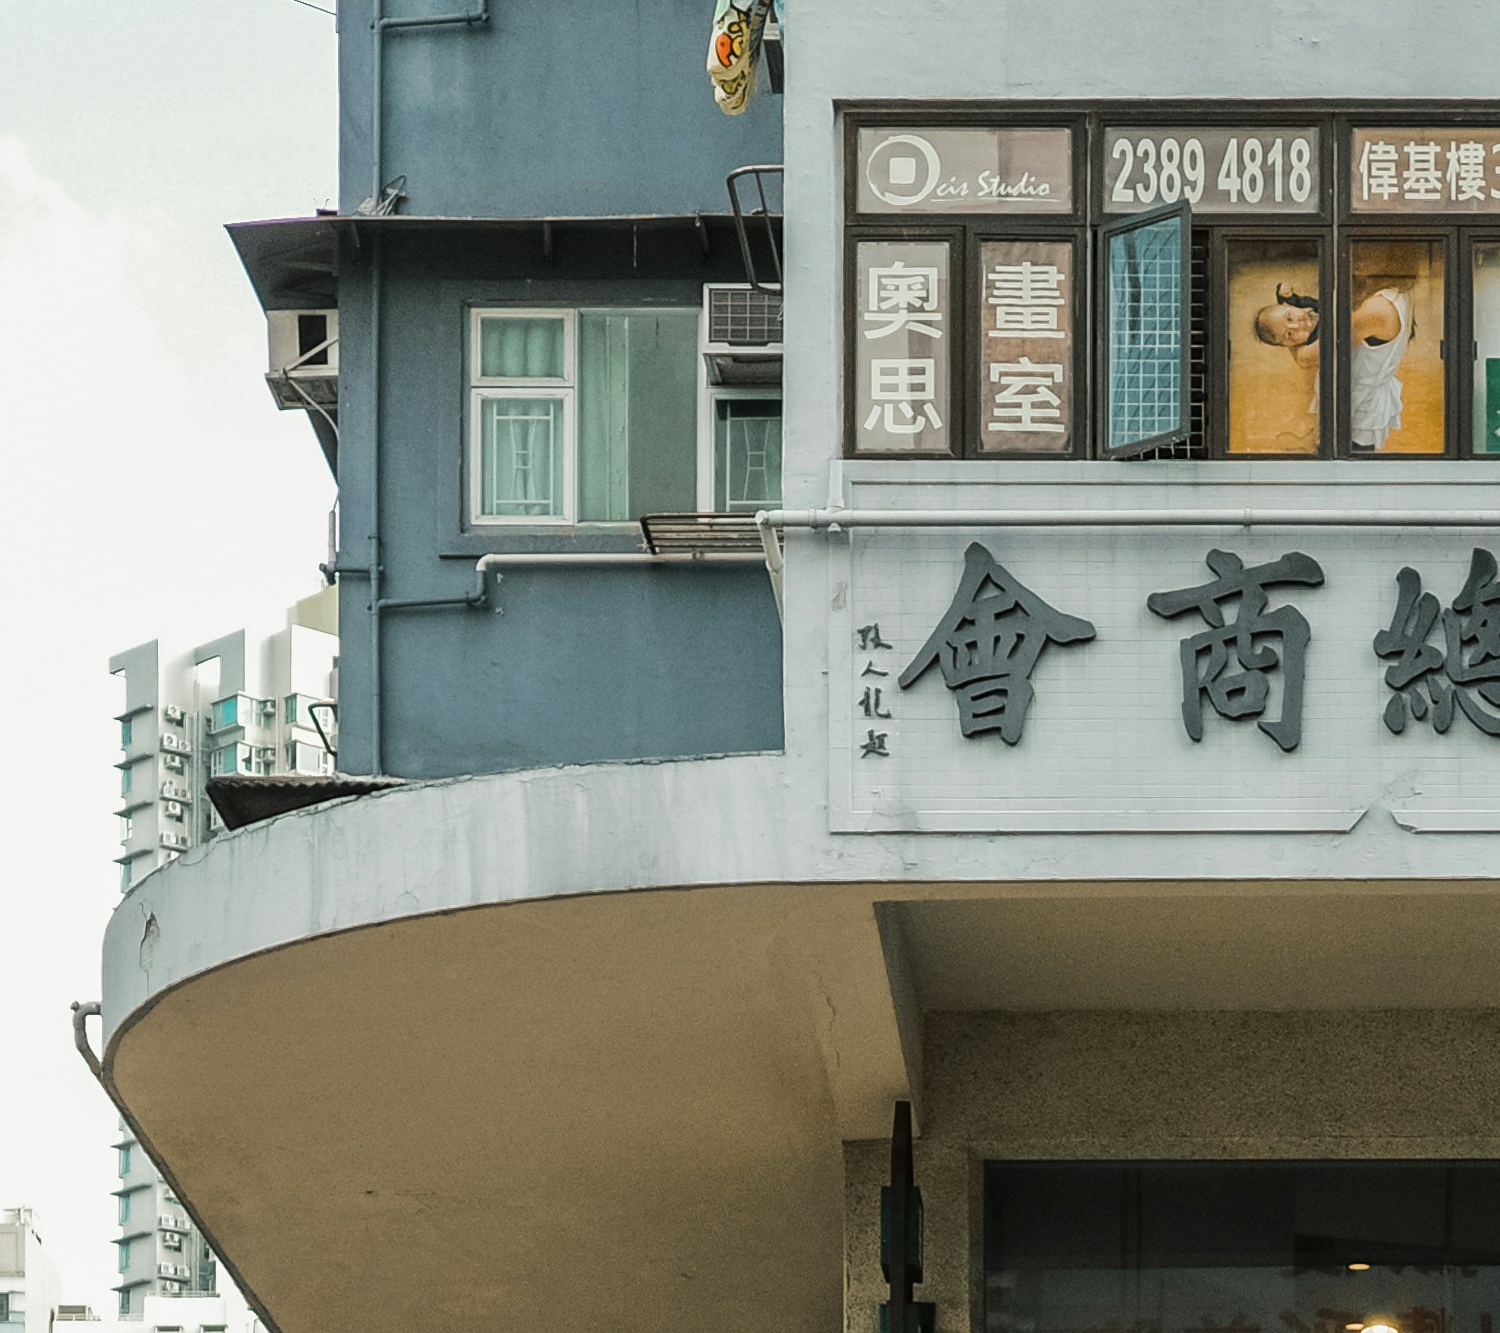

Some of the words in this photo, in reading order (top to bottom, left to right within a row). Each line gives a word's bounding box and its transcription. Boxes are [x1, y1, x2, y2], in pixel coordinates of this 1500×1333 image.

[977, 170, 1052, 199] Studio
[1111, 138, 1205, 203] 2389
[1218, 138, 1311, 203] 4818
[863, 261, 944, 435] 奧思
[987, 261, 1067, 435] 畫室
